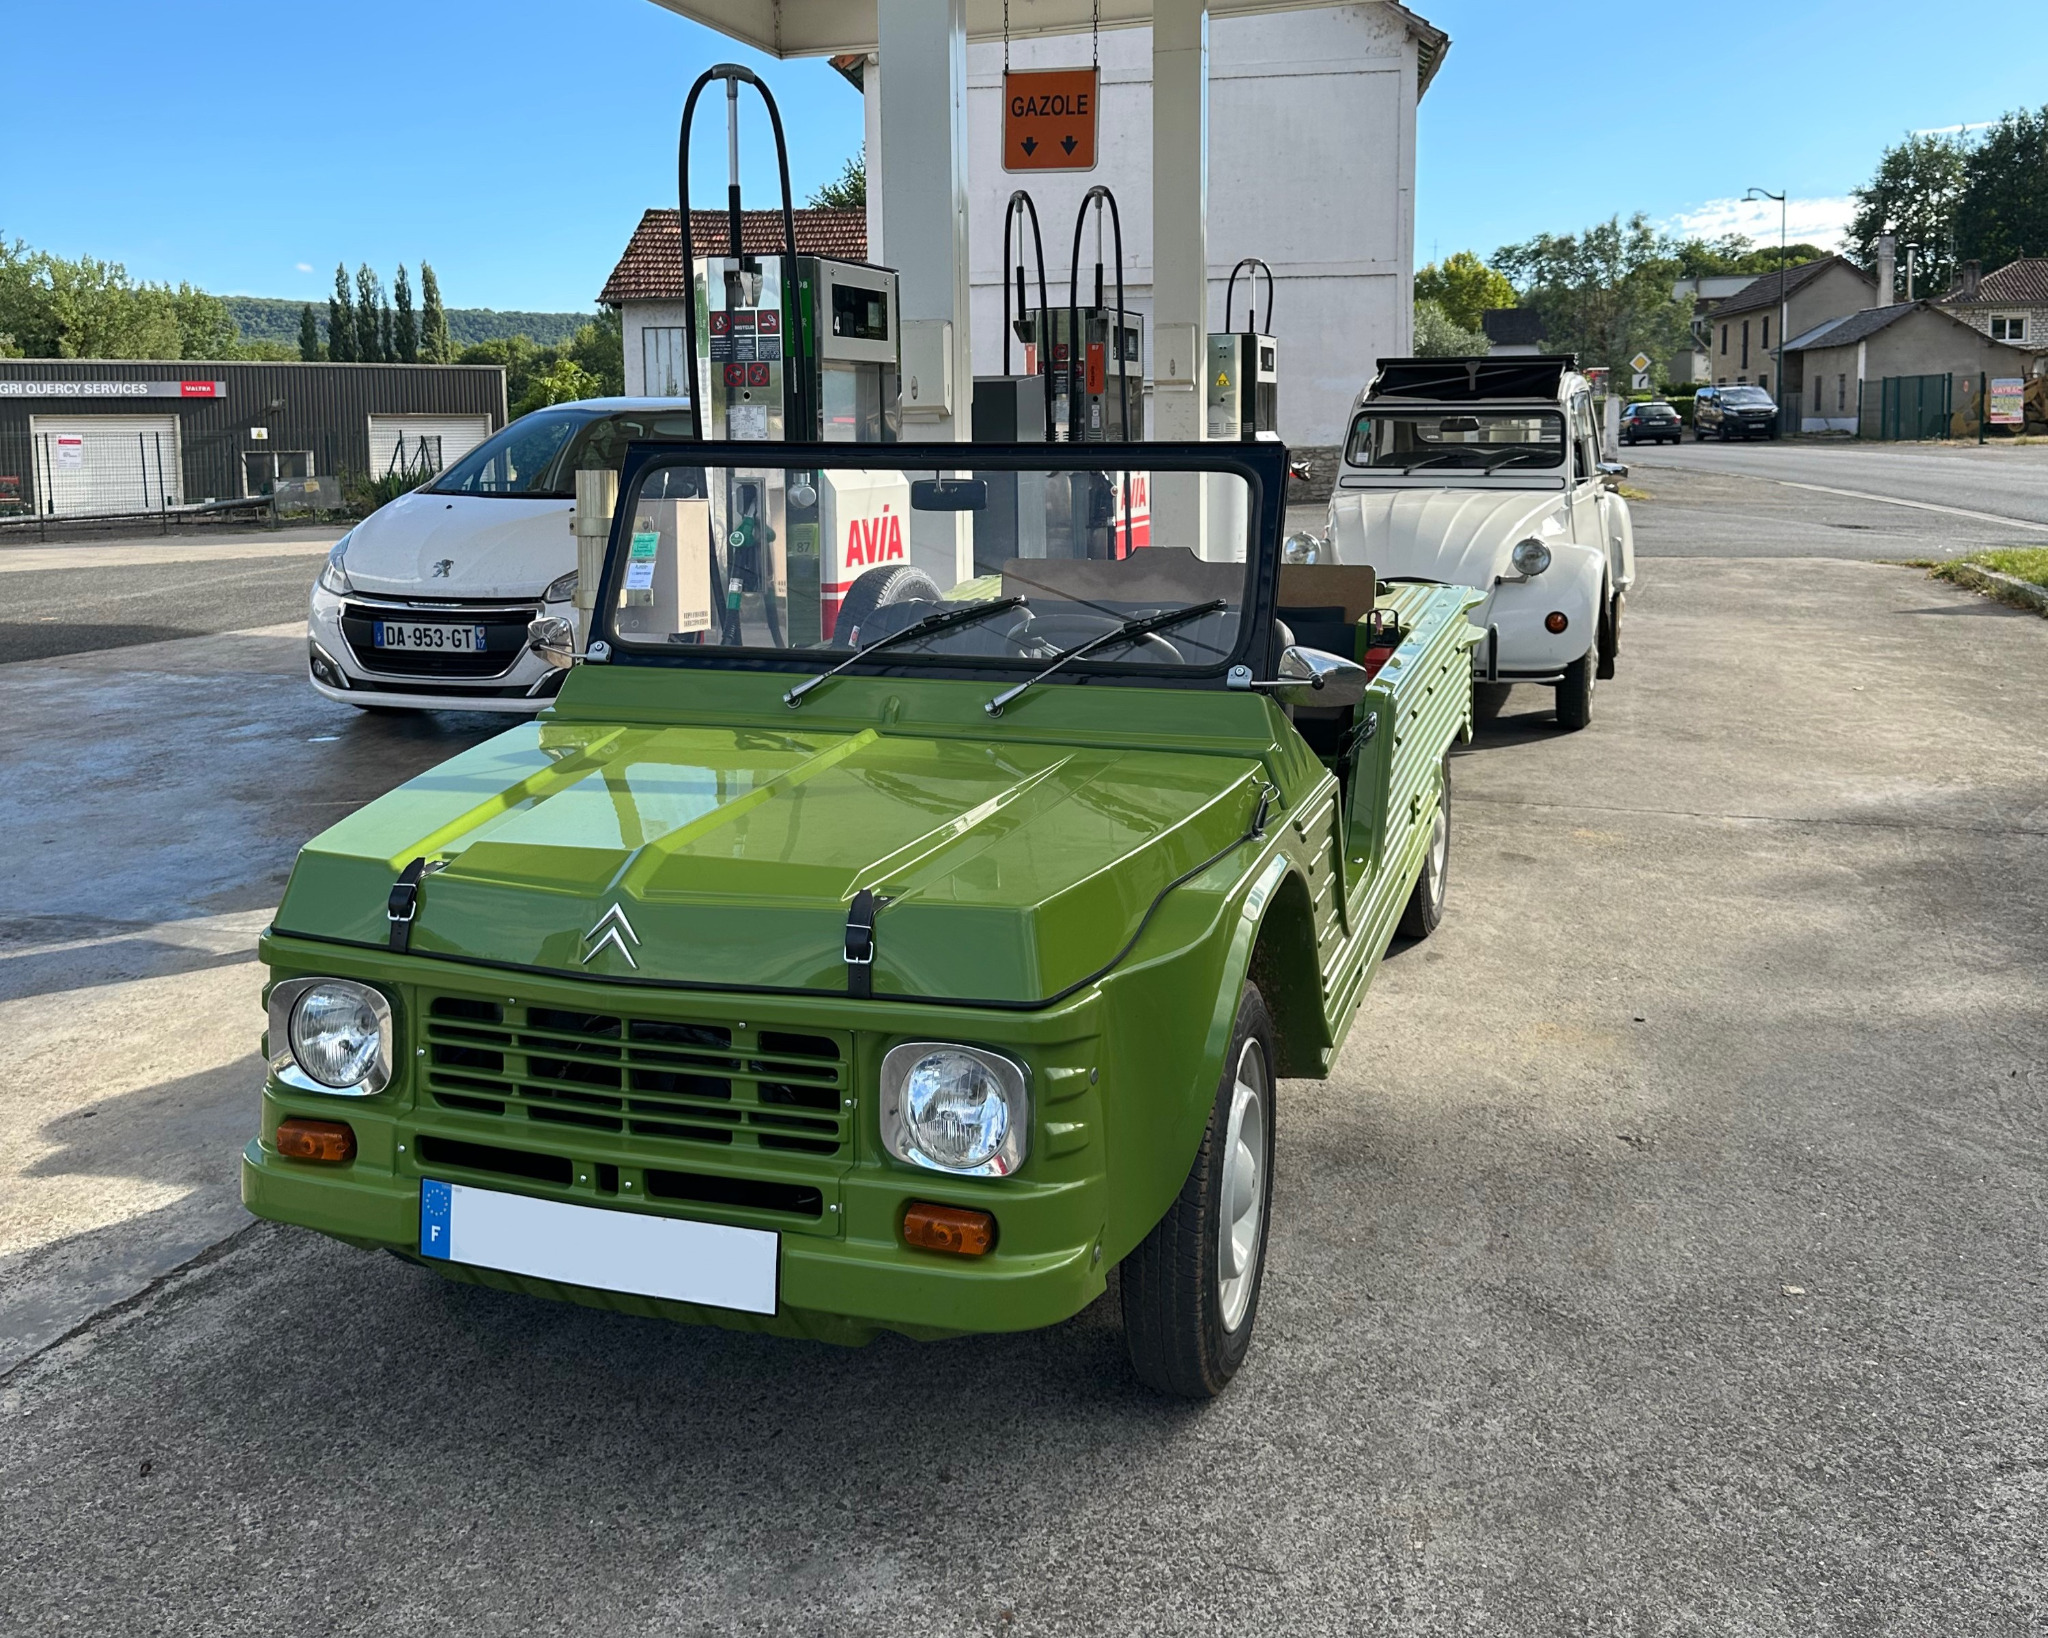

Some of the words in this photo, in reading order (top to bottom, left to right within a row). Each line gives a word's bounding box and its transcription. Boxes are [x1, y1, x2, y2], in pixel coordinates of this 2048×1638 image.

[1011, 94, 1088, 117] GAZOLE
[834, 316, 840, 334] 4
[0, 383, 22, 394] GRI
[26, 383, 81, 394] QUERCY
[84, 383, 148, 394] SERVICES
[385, 626, 472, 649] DA-953-GT
[476, 639, 485, 649] 17
[431, 1225, 441, 1242] F
